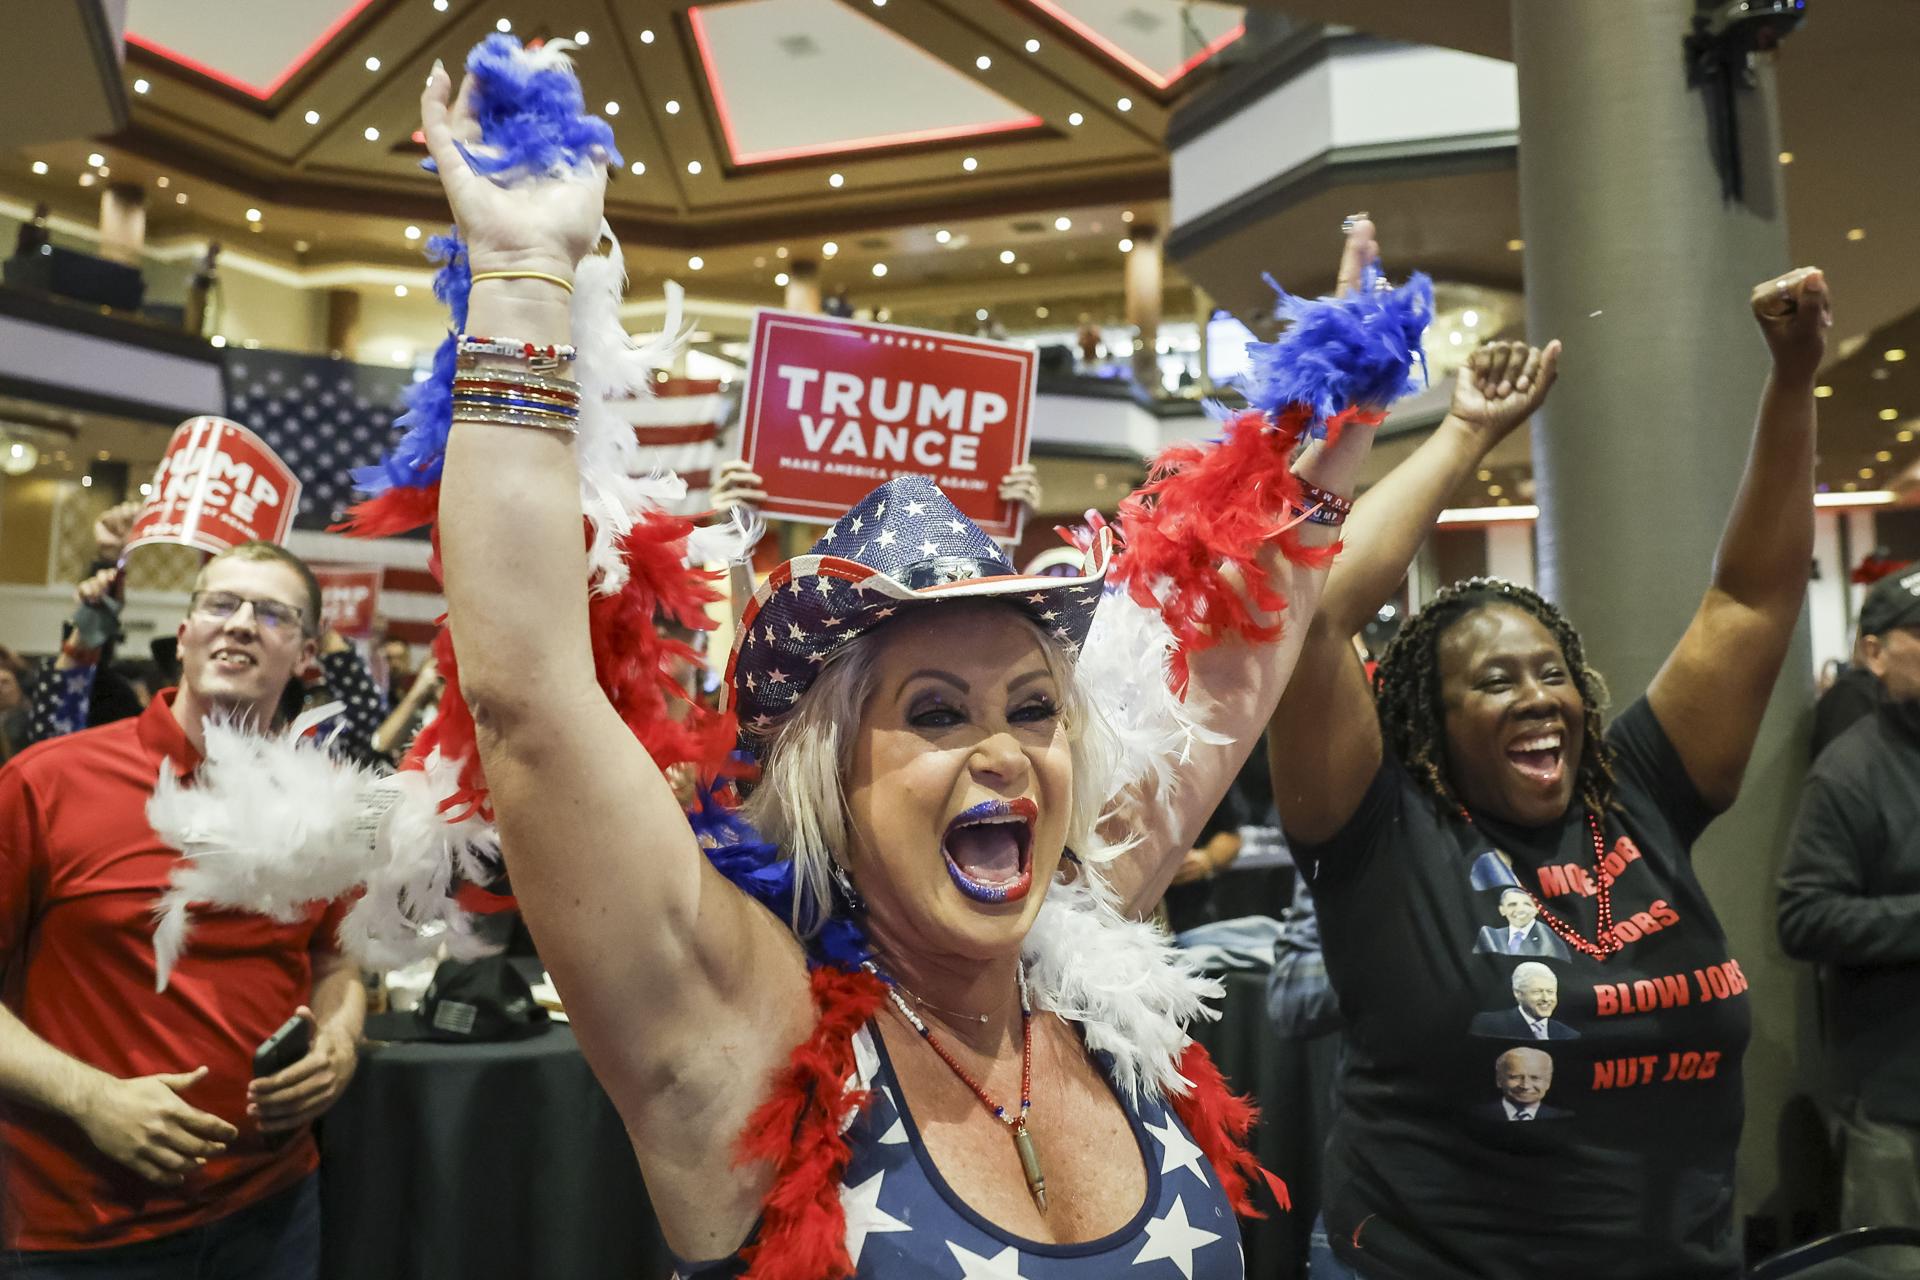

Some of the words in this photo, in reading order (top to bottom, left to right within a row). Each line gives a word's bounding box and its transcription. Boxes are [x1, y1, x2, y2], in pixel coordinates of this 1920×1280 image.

[778, 365, 1008, 433] TRUMP
[799, 415, 980, 471] VANCE
[779, 456, 820, 472] MAKE
[824, 461, 888, 480] AMERICA
[940, 475, 989, 491] AGAIN!
[1593, 973, 1690, 1017] BLOW
[1592, 1055, 1659, 1091] NUT
[1662, 1050, 1722, 1082] JOB
